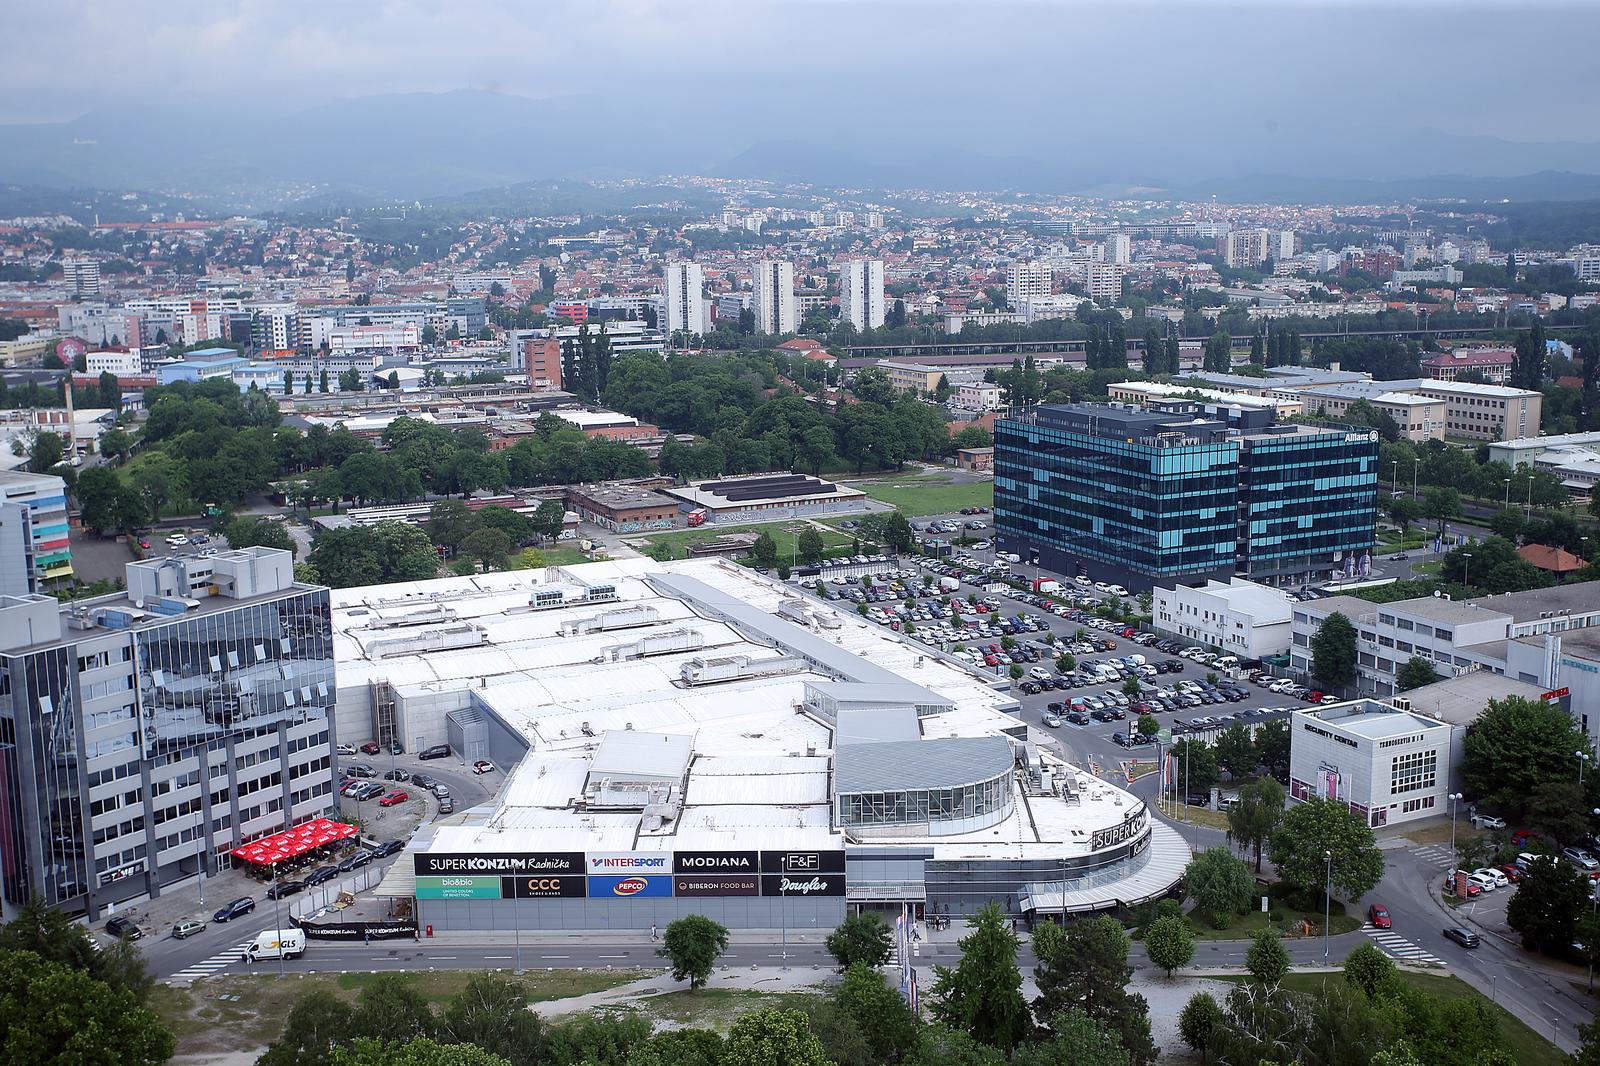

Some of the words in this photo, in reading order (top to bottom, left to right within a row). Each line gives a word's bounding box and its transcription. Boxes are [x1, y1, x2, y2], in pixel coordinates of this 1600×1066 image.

[1345, 433, 1369, 442] Allianz
[1304, 723, 1334, 739] SECURITY
[1334, 734, 1358, 748] CENTAR
[527, 857, 570, 869] Radnička
[604, 858, 666, 867] INTERSPORT
[682, 857, 750, 867] MODIANA
[789, 855, 817, 868] F&F
[442, 878, 473, 886] bio&bio
[528, 879, 561, 890] CCC
[618, 882, 643, 890] PEPCO
[780, 876, 828, 894] Douglas
[280, 939, 296, 948] GLS
